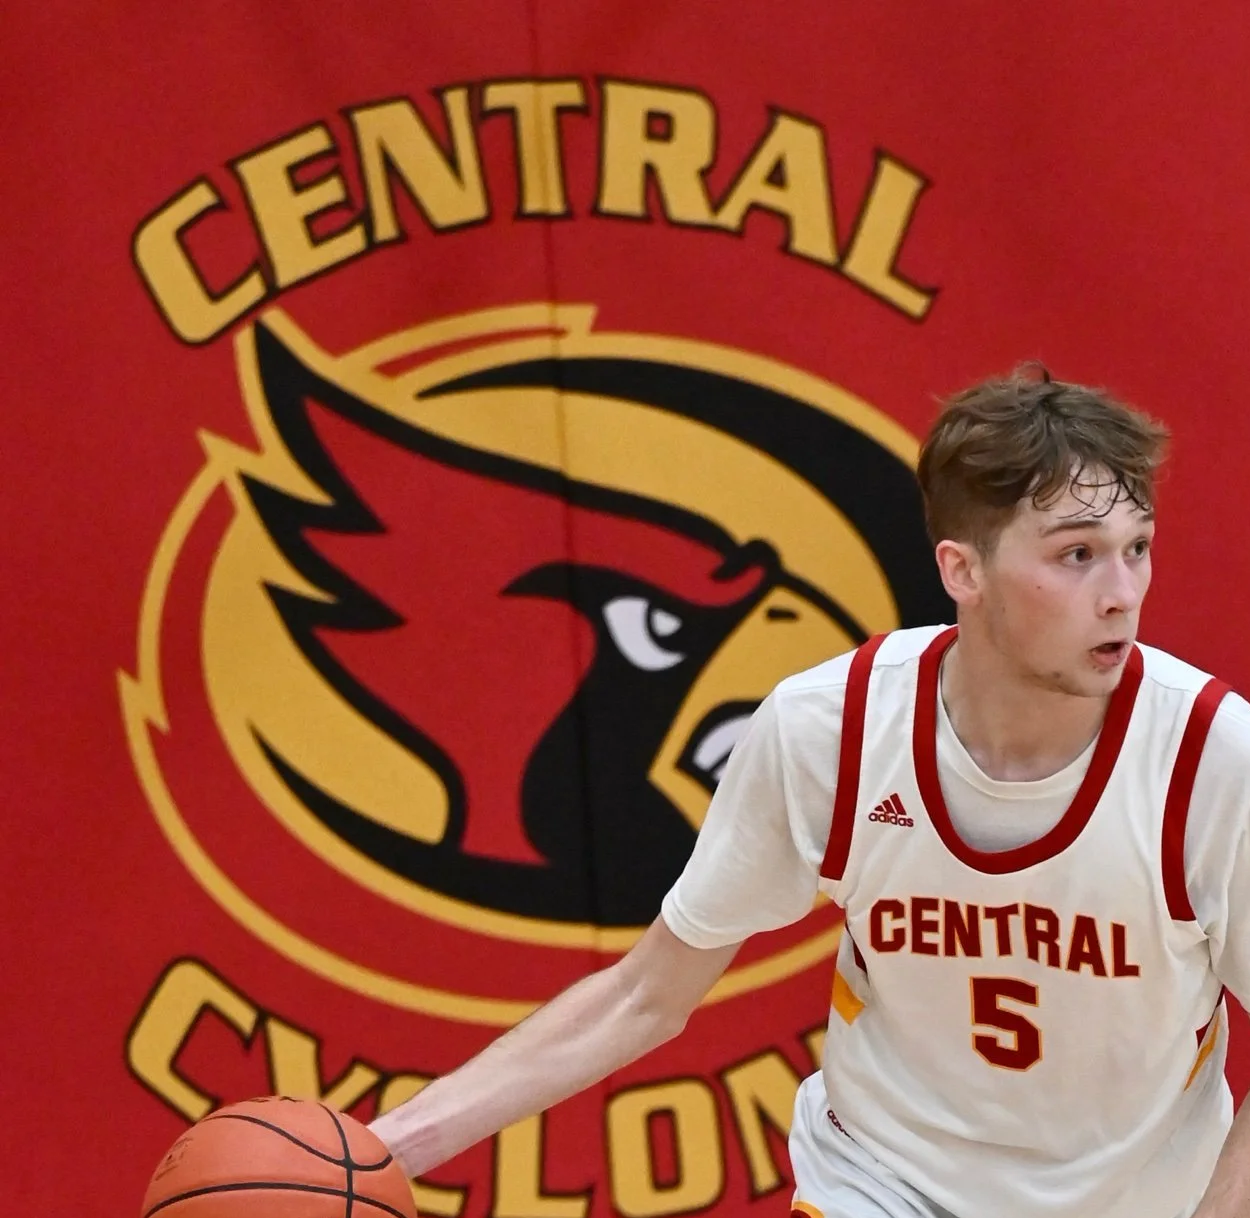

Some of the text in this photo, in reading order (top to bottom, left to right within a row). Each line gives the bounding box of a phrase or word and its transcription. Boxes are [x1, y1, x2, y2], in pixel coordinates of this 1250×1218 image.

[130, 75, 940, 345] CENTRAL
[868, 810, 915, 828] adidas
[868, 895, 1141, 979] CENTRAL
[969, 976, 1042, 1073] 5
